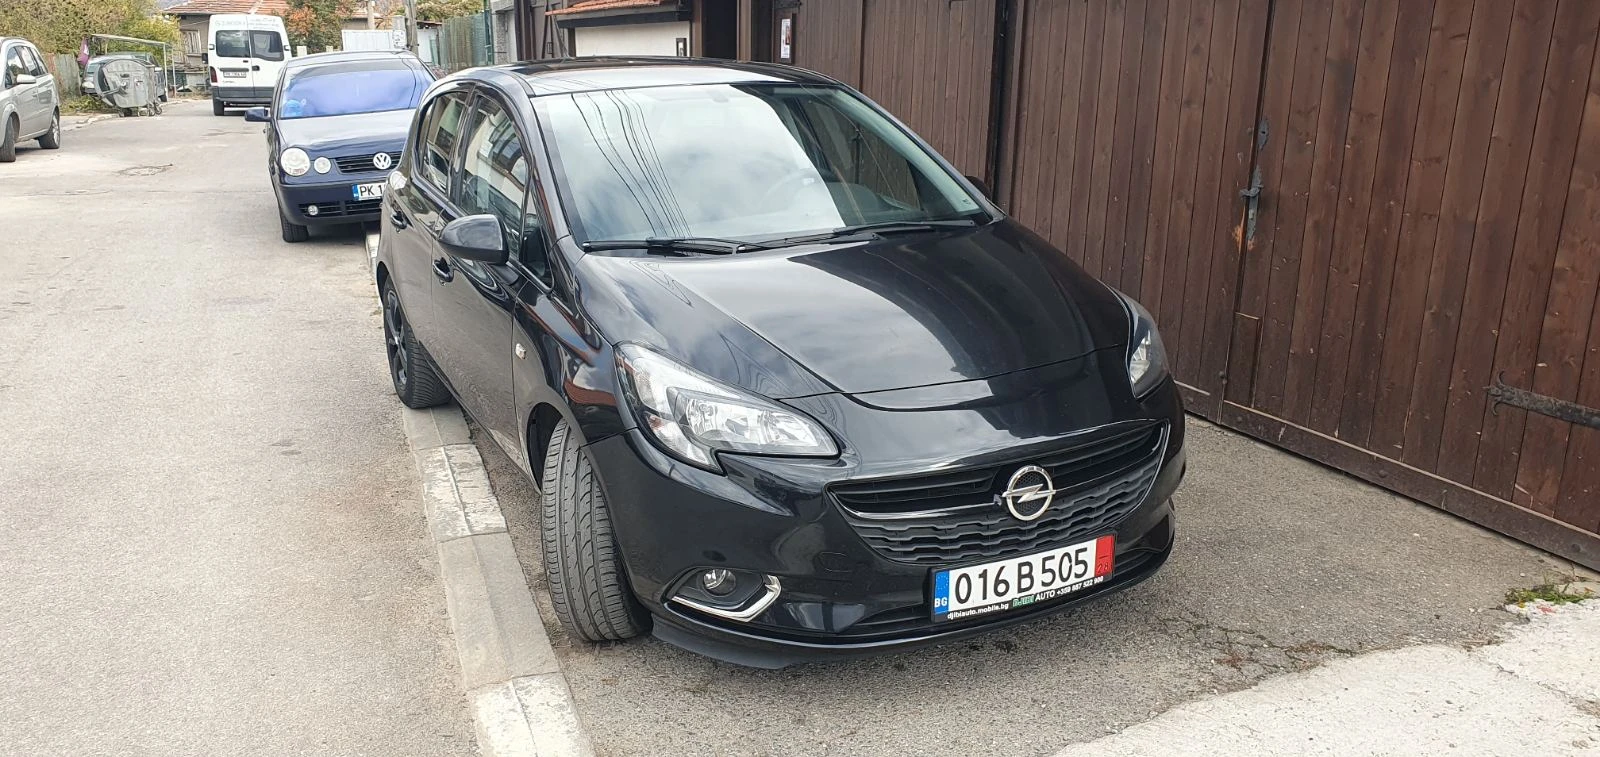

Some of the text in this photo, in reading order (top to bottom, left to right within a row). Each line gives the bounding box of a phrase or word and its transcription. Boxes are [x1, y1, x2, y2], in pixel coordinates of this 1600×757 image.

[359, 185, 374, 196] PK
[955, 547, 1088, 604] 016 B 505
[1035, 590, 1055, 602] AUTO
[934, 597, 948, 608] BG
